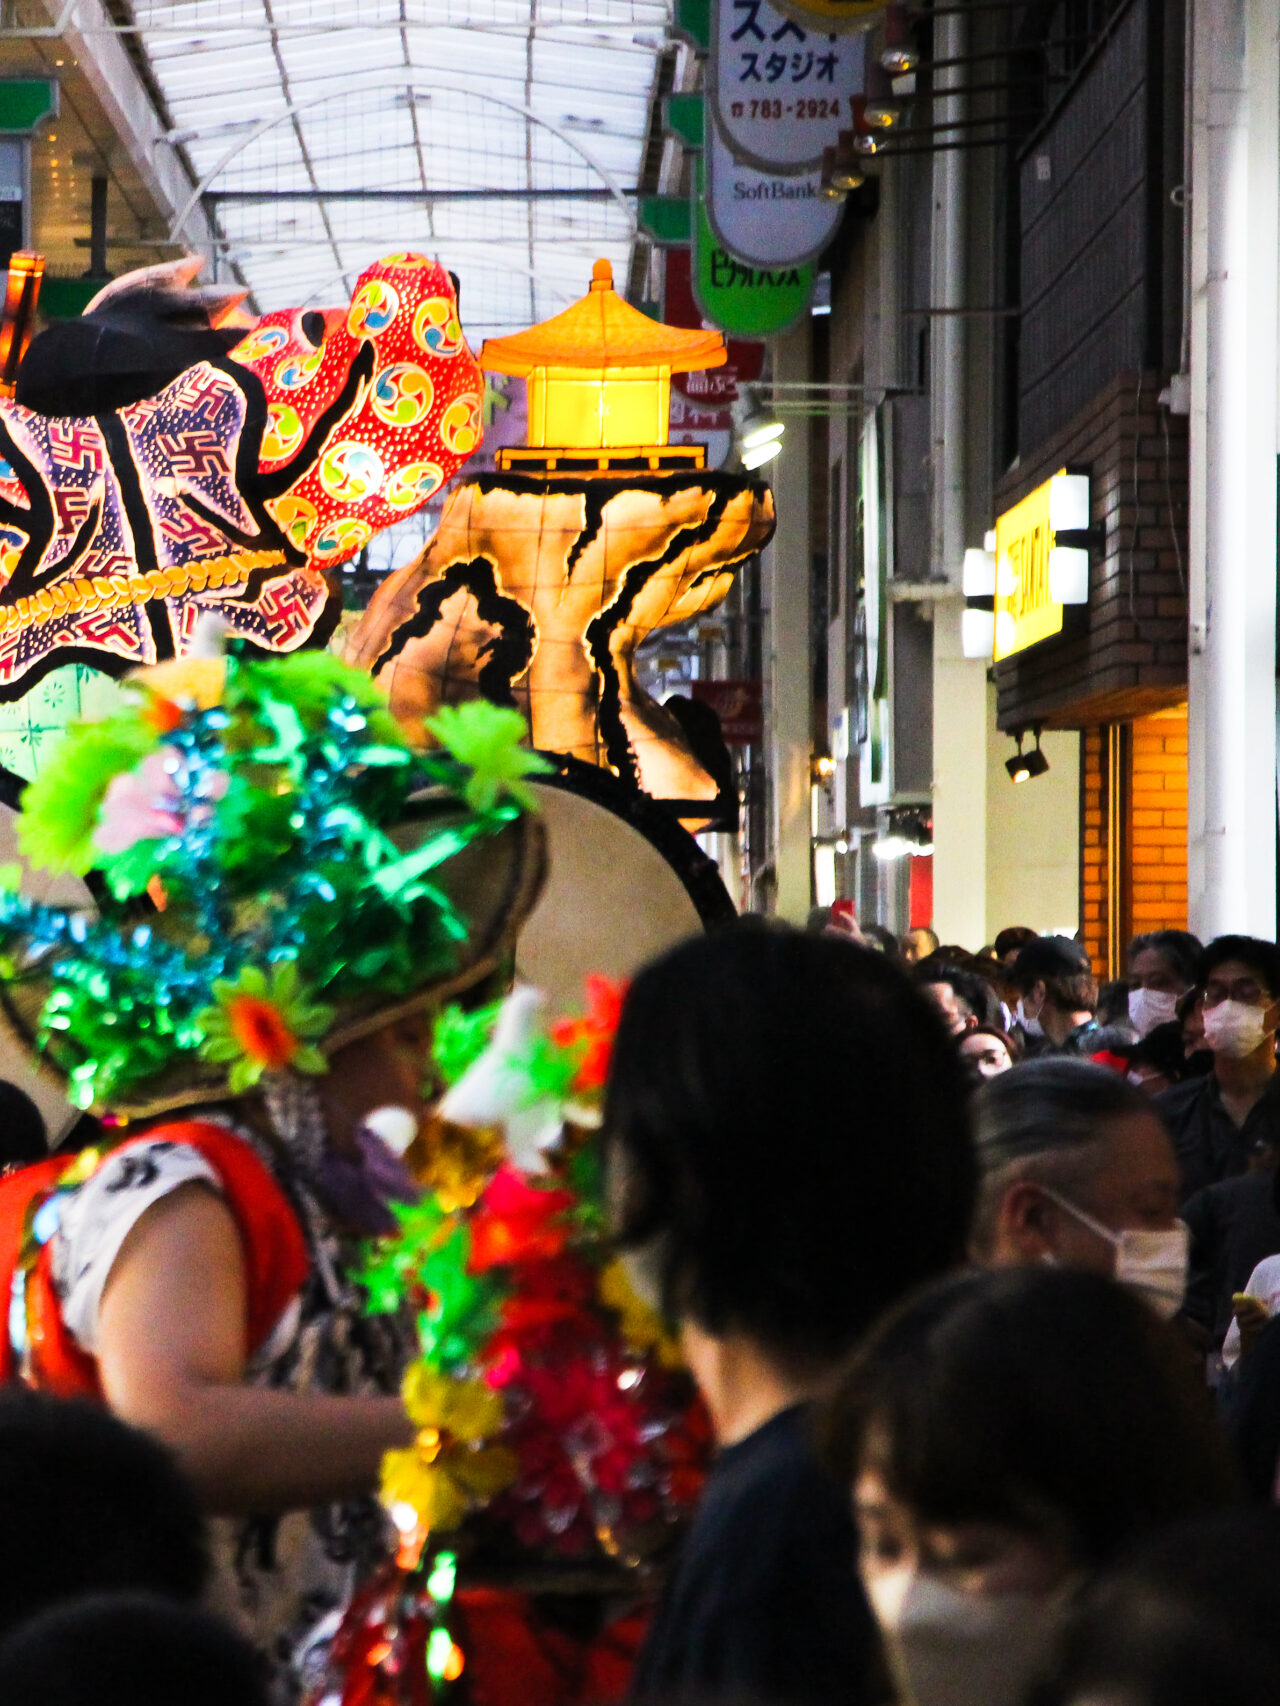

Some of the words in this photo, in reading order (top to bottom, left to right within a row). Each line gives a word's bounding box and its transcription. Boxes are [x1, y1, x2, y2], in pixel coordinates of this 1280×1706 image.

[739, 52, 838, 83] スタジオ
[751, 99, 840, 119] 783-2924
[733, 182, 818, 199] SoftBank
